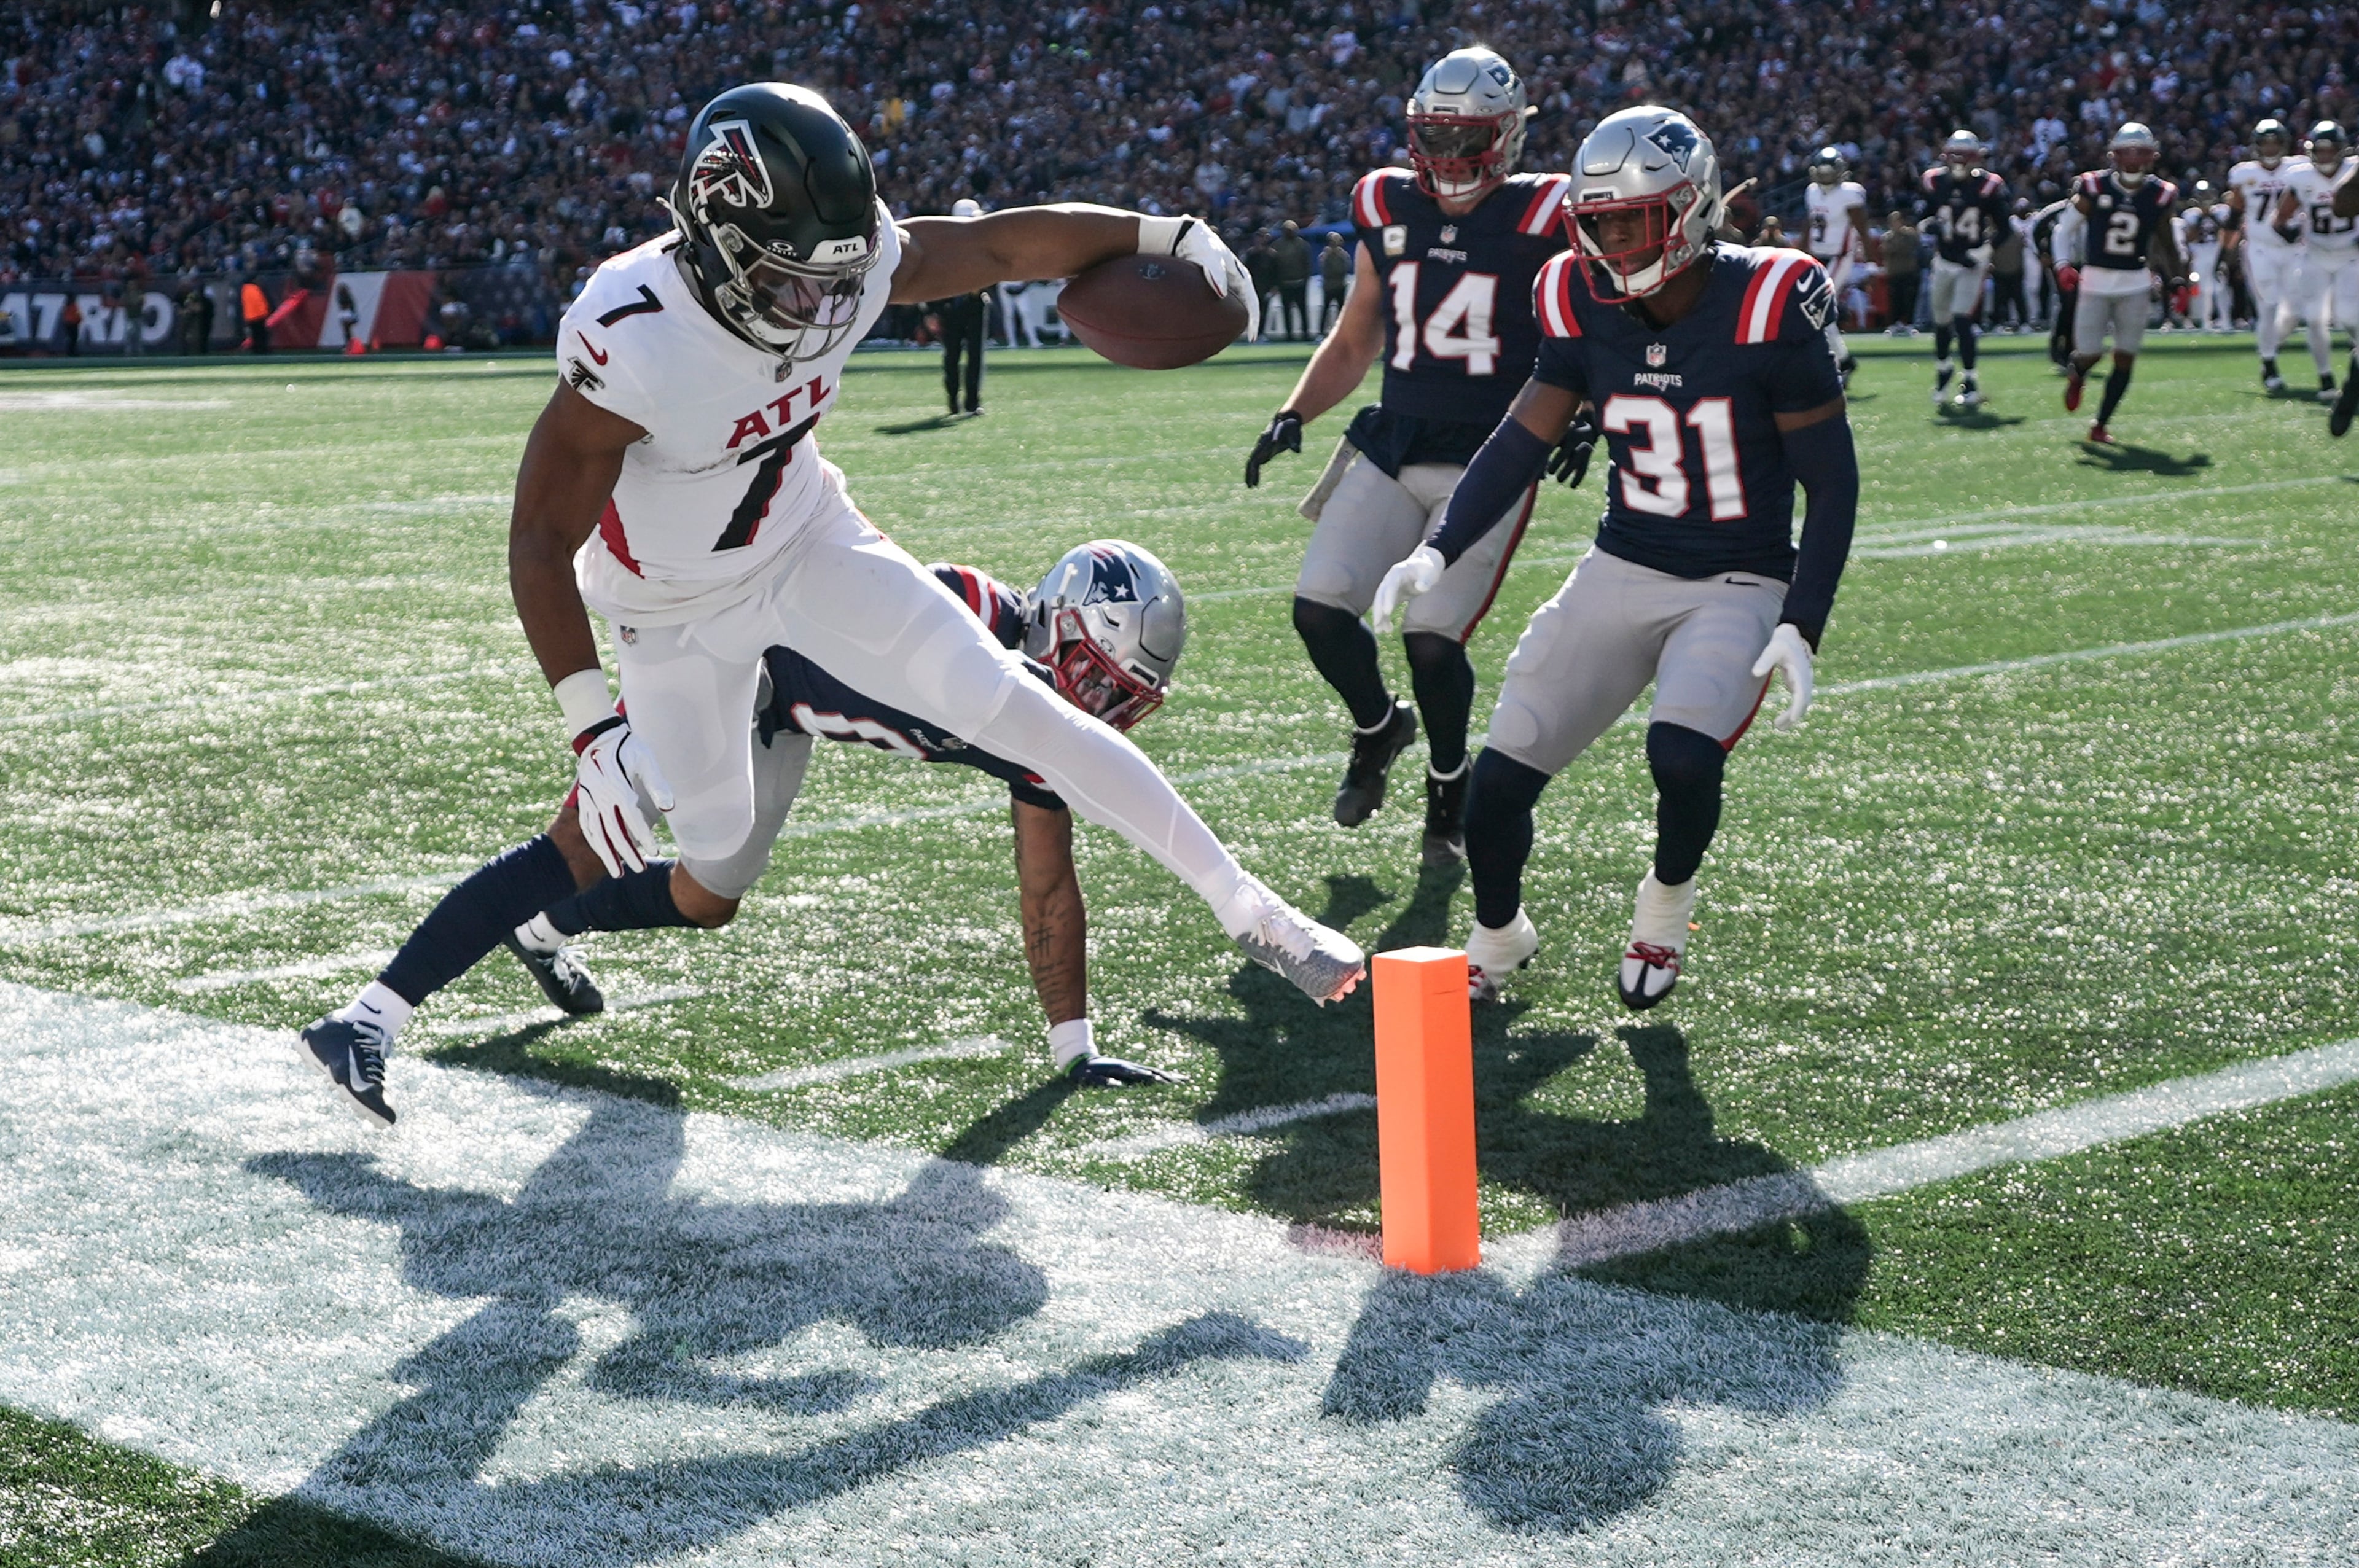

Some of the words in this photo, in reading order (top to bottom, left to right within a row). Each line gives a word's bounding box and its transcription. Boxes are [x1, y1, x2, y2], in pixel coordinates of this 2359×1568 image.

[833, 243, 858, 254] ATL
[2104, 211, 2139, 255] 2
[595, 283, 664, 327] 7
[1389, 261, 1500, 375] 14
[1634, 373, 1683, 388] PATRIOTS
[718, 375, 831, 449] ATL
[711, 411, 820, 552] 7
[1602, 393, 1748, 521] 31
